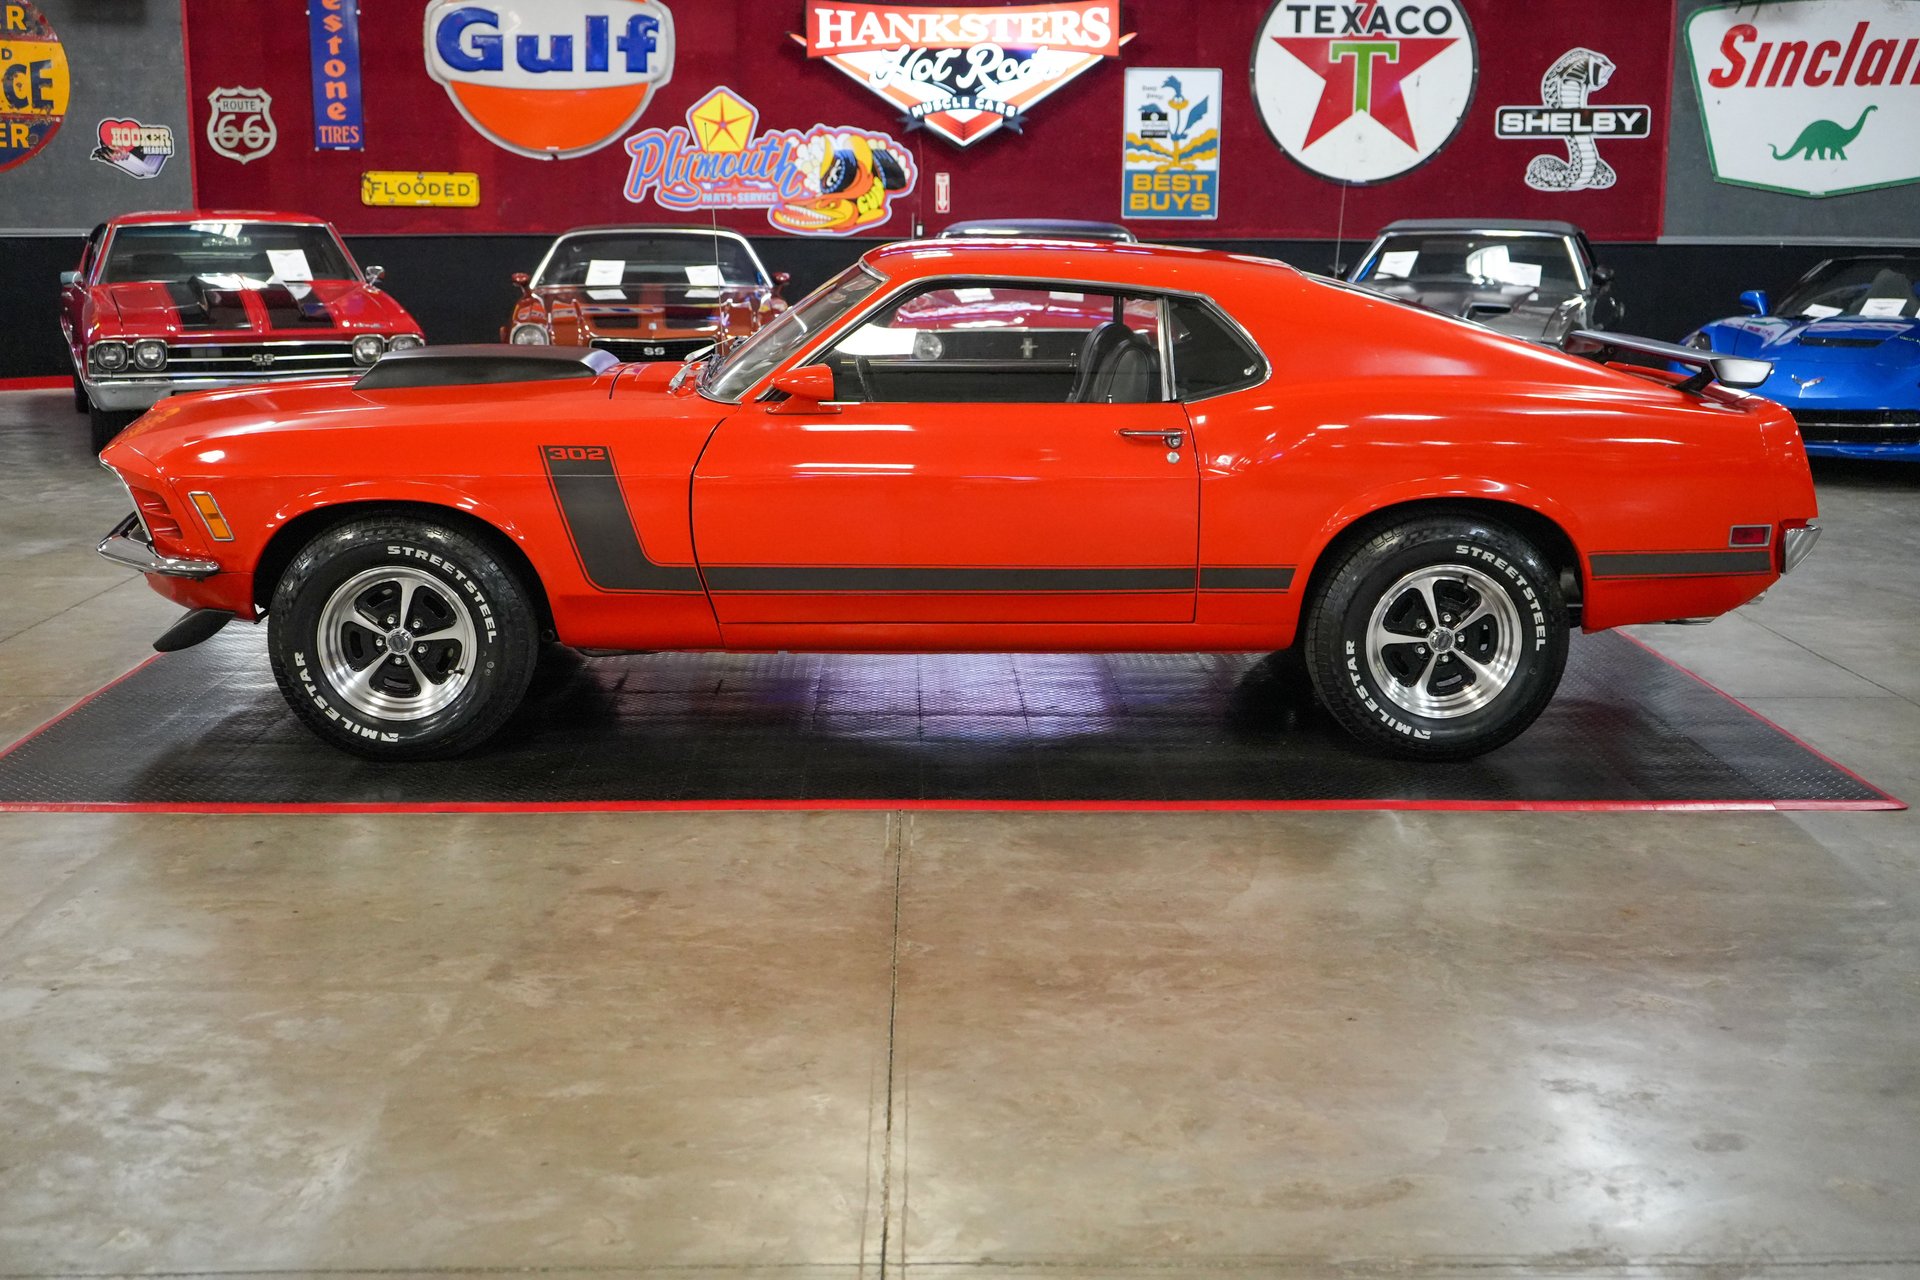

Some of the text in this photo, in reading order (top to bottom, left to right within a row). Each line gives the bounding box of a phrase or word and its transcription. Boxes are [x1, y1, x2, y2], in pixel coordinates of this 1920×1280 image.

[814, 7, 1111, 49] HANKSTERS
[1286, 5, 1453, 35] TEXACO
[436, 7, 660, 73] Gulf
[1708, 21, 1920, 88] Sinclai
[869, 44, 962, 89] Hot
[222, 101, 256, 111] ROUTE
[911, 96, 1017, 119] MUSCLE CARS
[217, 114, 265, 149] 66
[1502, 112, 1642, 133] SHELBY
[110, 127, 172, 148] HOOKER
[319, 125, 360, 144] TIRES
[632, 134, 802, 203] Plymouth
[371, 181, 471, 197] FLOODED
[1132, 173, 1209, 192] BEST
[737, 192, 778, 202] SERVICE
[1129, 193, 1211, 211] BUYS
[643, 347, 665, 355] SS
[548, 447, 606, 460] 302
[294, 651, 378, 740] MILESTAR
[1346, 640, 1411, 736] MILESTAR
